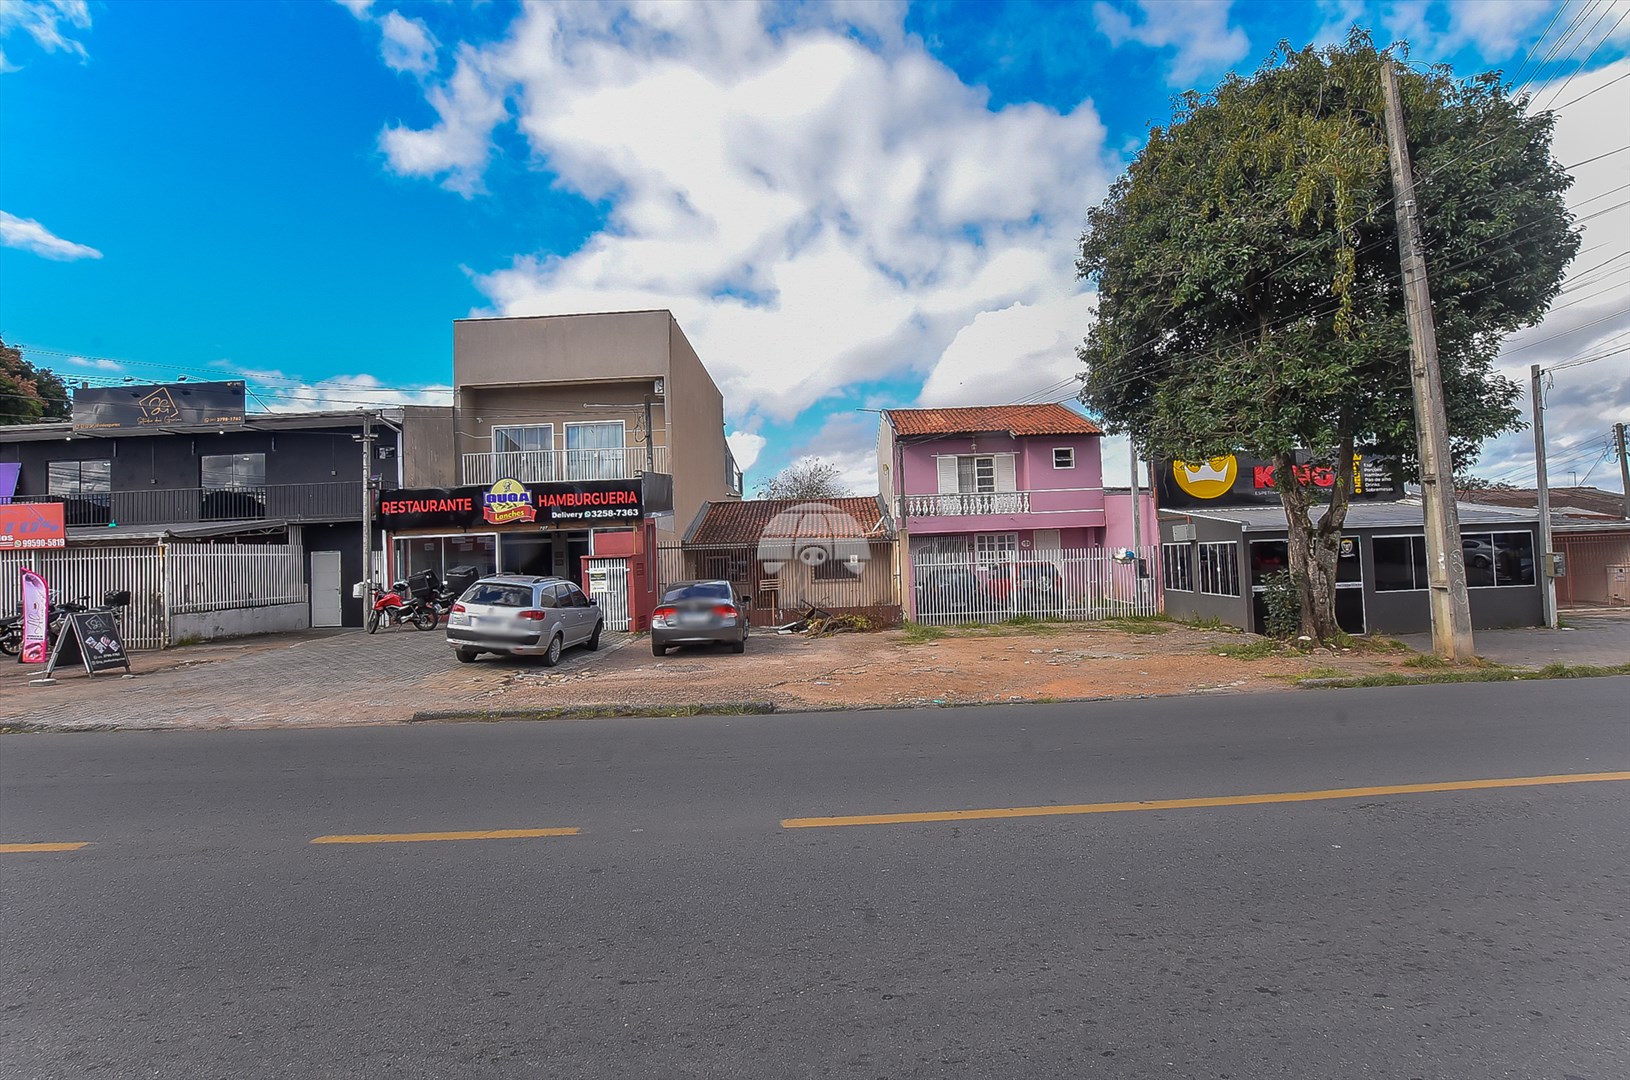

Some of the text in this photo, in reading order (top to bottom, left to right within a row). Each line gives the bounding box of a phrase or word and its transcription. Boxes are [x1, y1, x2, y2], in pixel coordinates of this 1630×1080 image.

[381, 498, 473, 514] RESTAURANTE
[538, 491, 638, 508] HAMBURGUERIA
[551, 508, 639, 519] Delivery 3258-7363
[22, 538, 65, 547] 99590-5819
